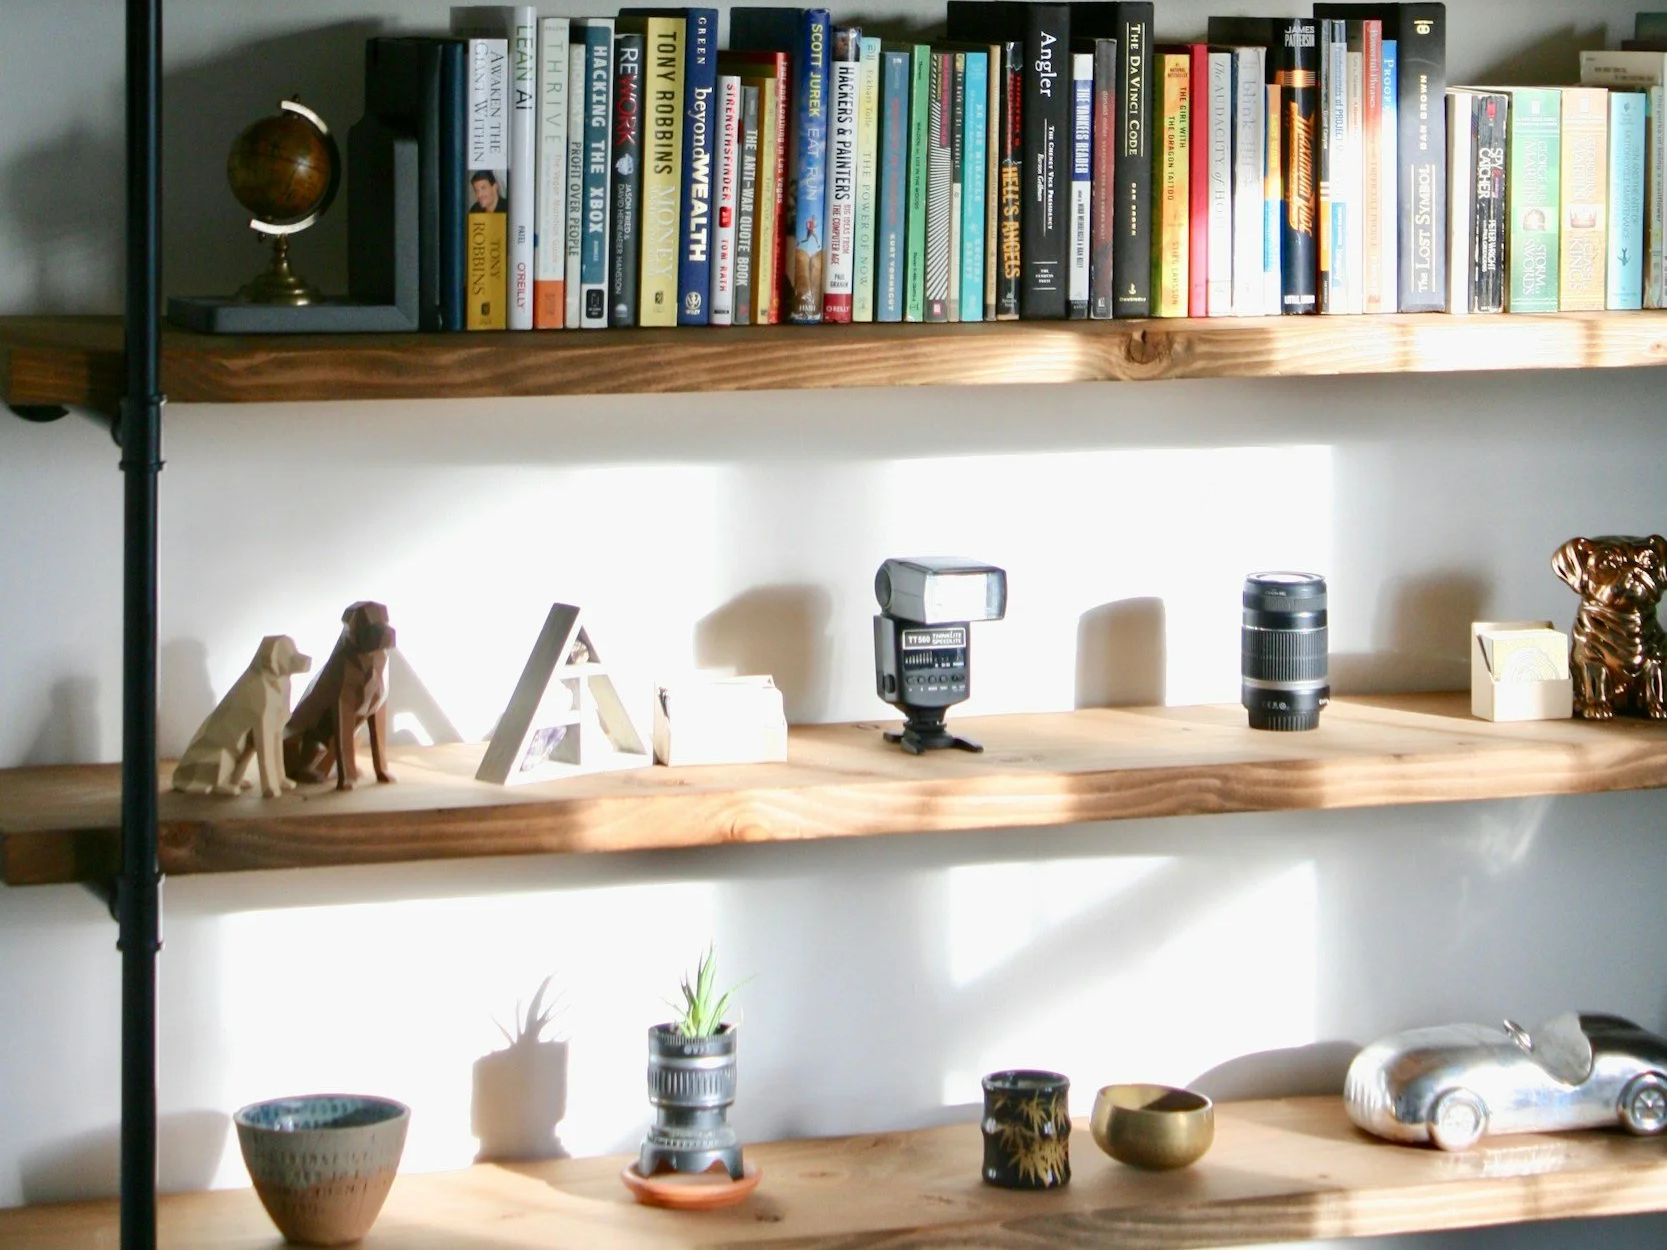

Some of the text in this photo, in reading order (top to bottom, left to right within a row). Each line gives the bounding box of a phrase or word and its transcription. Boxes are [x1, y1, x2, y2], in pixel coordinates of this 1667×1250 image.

[697, 16, 708, 65] GREEN
[1284, 25, 1315, 34] JAMES
[1284, 33, 1315, 47] PATTERSON
[1369, 29, 1378, 71] Powerful
[515, 25, 533, 110] LEAN AI
[780, 61, 788, 80] Fear
[1035, 31, 1057, 97] Angler
[473, 42, 488, 162] GIANT WITHIN
[489, 50, 504, 154] AWAKEN THE
[545, 42, 564, 143] THRIVE
[616, 47, 639, 147] REWORK
[653, 31, 677, 175] TONY ROBBINS
[780, 84, 788, 100] and
[806, 23, 823, 200] SCOTT JUREK EAT RUN
[864, 68, 874, 128] Eckhart Tolle
[1129, 24, 1141, 156] THE DA VINCI CODE
[1242, 79, 1257, 130] blink
[1369, 73, 1378, 109] Phrases
[589, 45, 607, 234] HACKING THE XBOX
[722, 83, 736, 200] STRENGTHSFINDER
[745, 130, 758, 150] THE
[778, 103, 787, 143] Loathing
[834, 66, 856, 200] HACKERS & PAINTERS
[975, 123, 983, 145] THE
[1047, 125, 1055, 141] THE
[1074, 88, 1090, 174] THE YANKEES READER
[1179, 127, 1187, 148] WITH
[1211, 61, 1226, 186] The AUDACITY of
[1335, 109, 1344, 141] PROJECT
[741, 154, 756, 211] ANTI-WAR
[974, 150, 983, 202] MIRACLE
[1415, 75, 1431, 293] The LOST SYMBOL DAN BROWN
[1479, 147, 1491, 199] CATCHER
[1490, 147, 1503, 170] SPY
[1524, 140, 1538, 208] MARTIN
[1573, 138, 1586, 200] MARTIN
[1632, 162, 1640, 179] AND
[1655, 147, 1663, 171] being
[568, 141, 582, 256] PROFIT OVER PEOPLE
[624, 183, 632, 209] JASON
[776, 178, 784, 204] Vegas
[1002, 166, 1020, 216] HELL'S
[1046, 190, 1054, 230] PRESIDENCY
[1167, 171, 1175, 201] TATTOO
[1622, 129, 1631, 240] MOTORCYCLE MAINTENANCE
[1632, 180, 1640, 195] THE
[1632, 197, 1640, 211] ART
[517, 225, 526, 245] PATEL
[614, 184, 625, 295] DAVID HEINEMEIER HANSSON
[624, 211, 632, 234] FRIED
[656, 184, 676, 279] MONEY
[738, 216, 753, 252] QUOTE
[831, 204, 841, 265] THE COMPUTER AGE
[843, 217, 851, 235] IDEAS
[859, 151, 872, 287] THE POWER OF NOW
[1632, 214, 1639, 226] OF
[472, 222, 485, 295] ROBBINS
[489, 239, 501, 280] TONY
[719, 239, 729, 292] TOM RATH
[841, 236, 850, 254] FROM
[888, 232, 896, 258] KURT
[1003, 222, 1020, 278] ANGELS
[1487, 219, 1497, 271] PETER WRIGHT
[1522, 239, 1535, 295] SWORDS
[1534, 243, 1547, 286] STORM
[1569, 237, 1583, 291] KINGS
[516, 262, 526, 309] O'REILLY
[735, 257, 749, 287] BOOK
[887, 260, 895, 312] VONNEGUT
[1171, 241, 1180, 305] STIEG LARSSON
